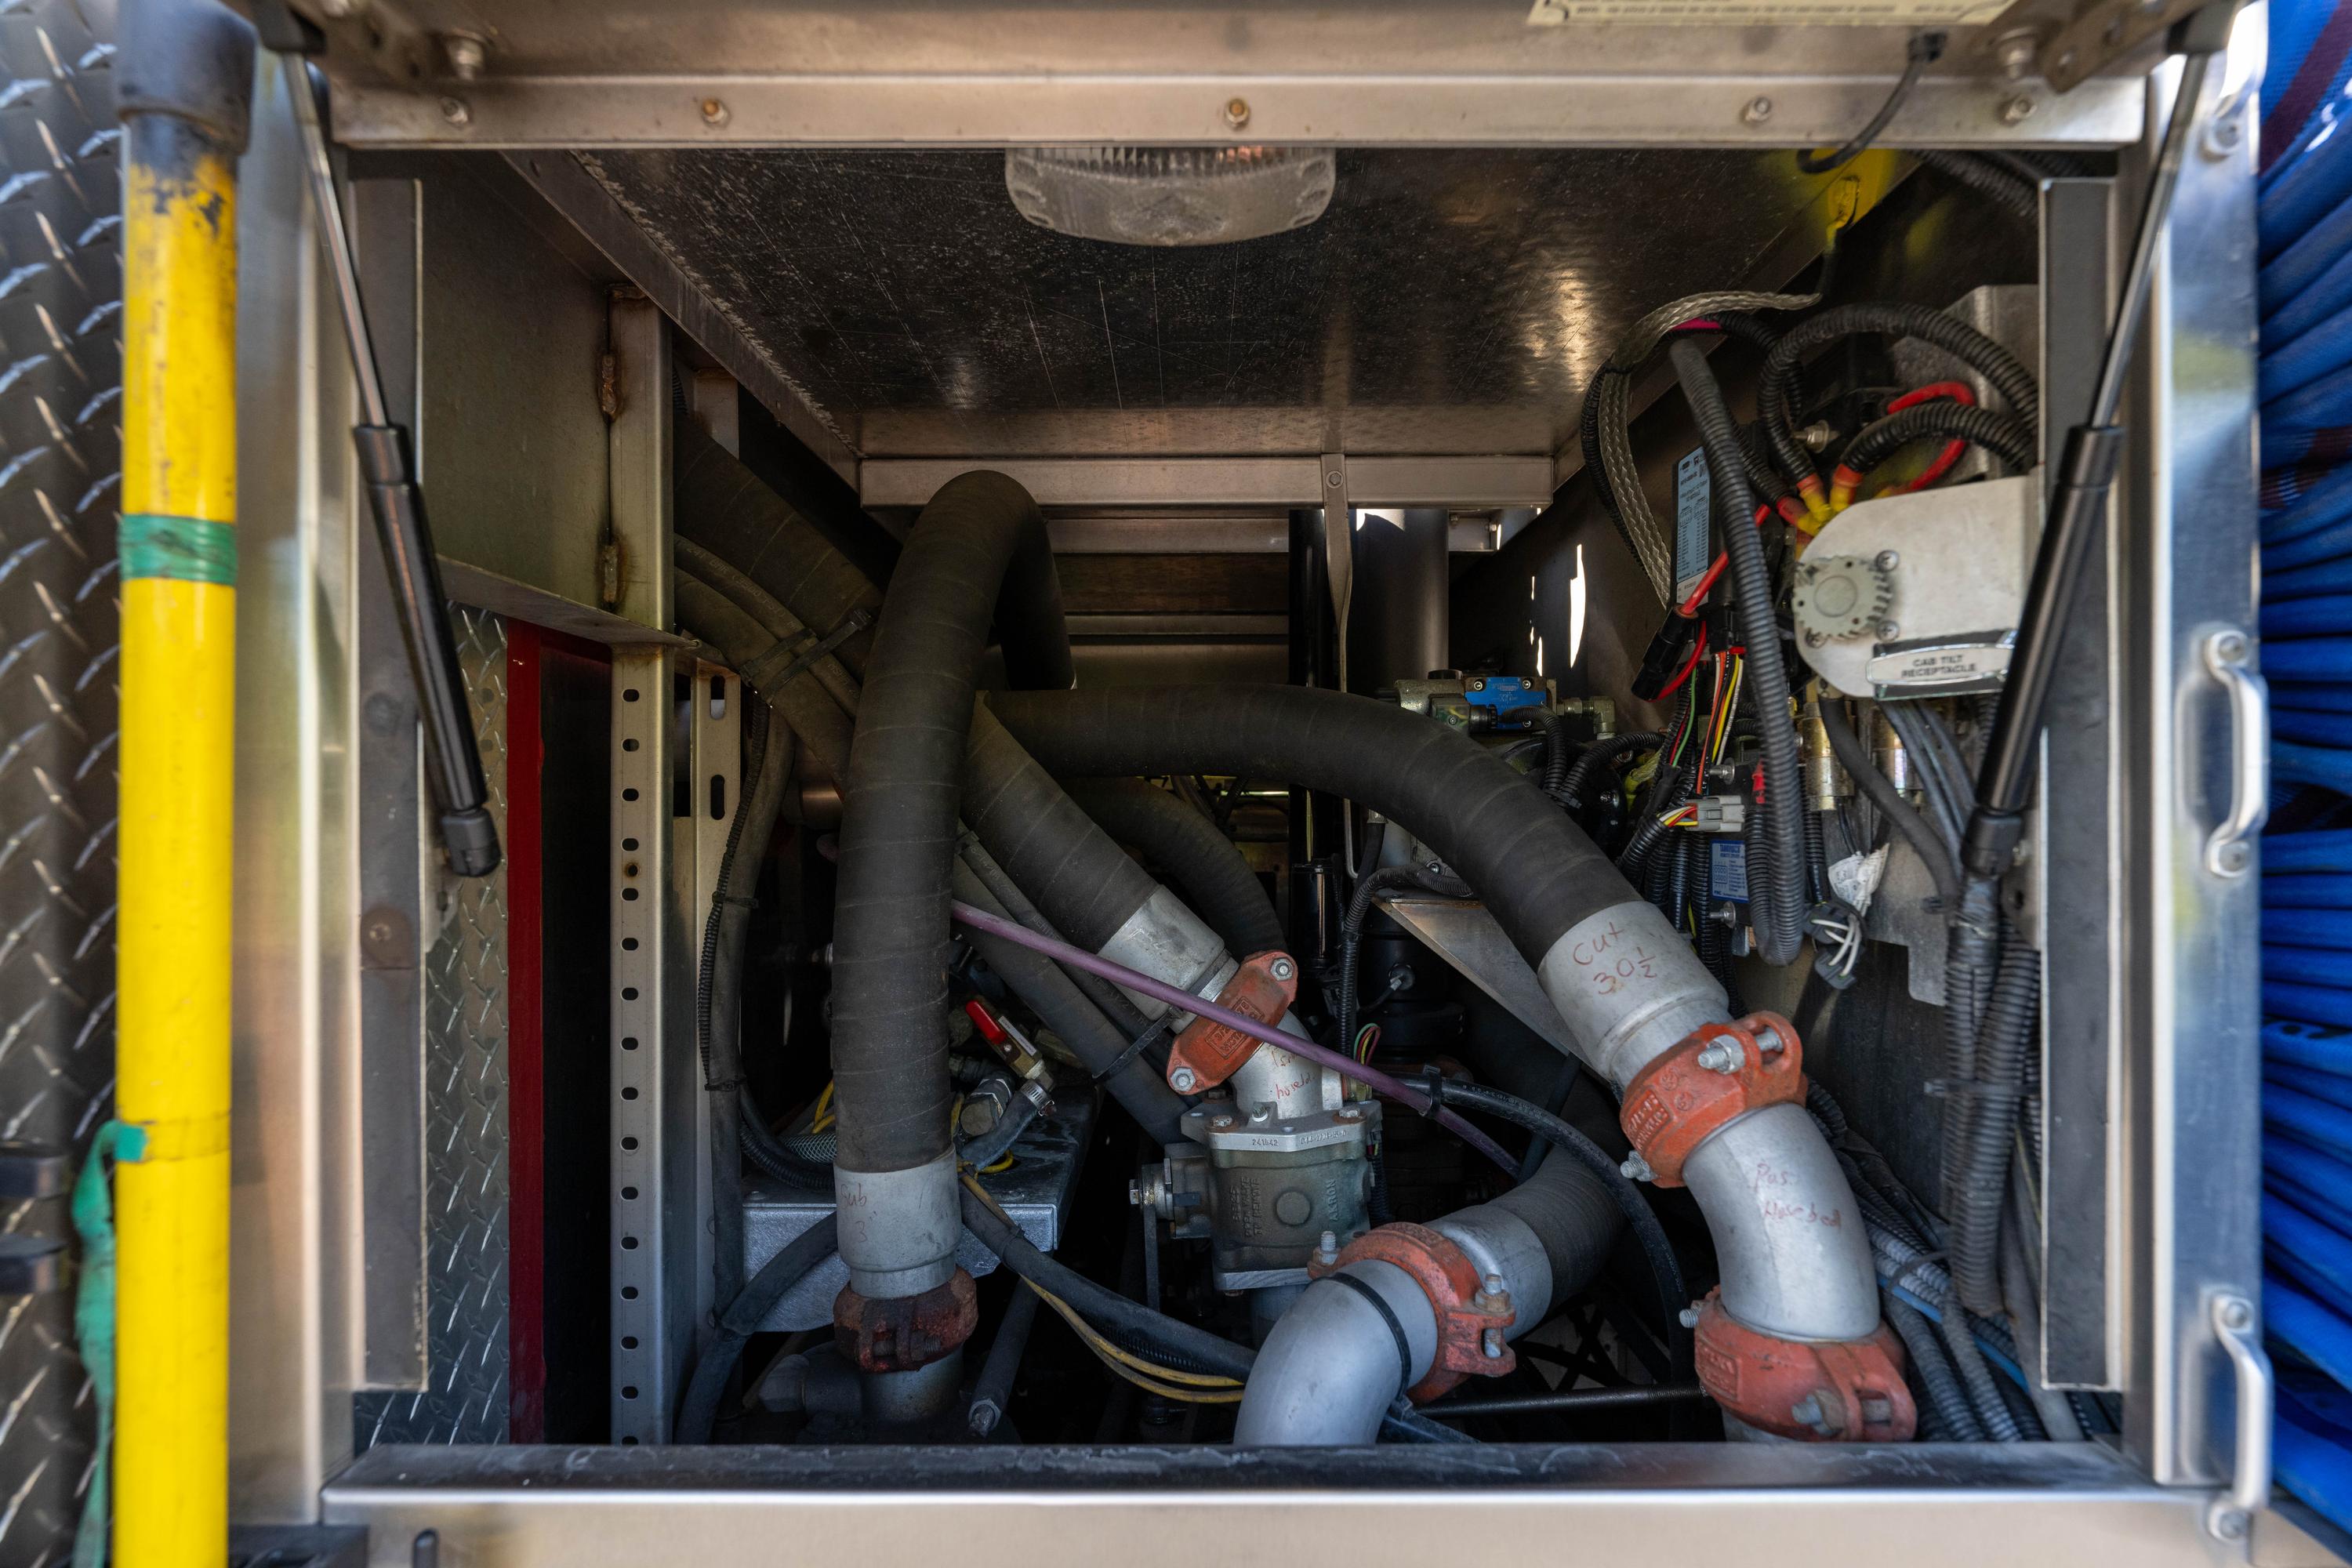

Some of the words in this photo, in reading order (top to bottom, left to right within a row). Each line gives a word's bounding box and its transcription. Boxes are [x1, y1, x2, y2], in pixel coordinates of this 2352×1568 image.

[1913, 657, 1937, 666] CAB
[1941, 655, 1963, 664] TILT
[1901, 663, 1976, 677] RECEPTACLE
[1327, 1178, 1338, 1222] AKRON
